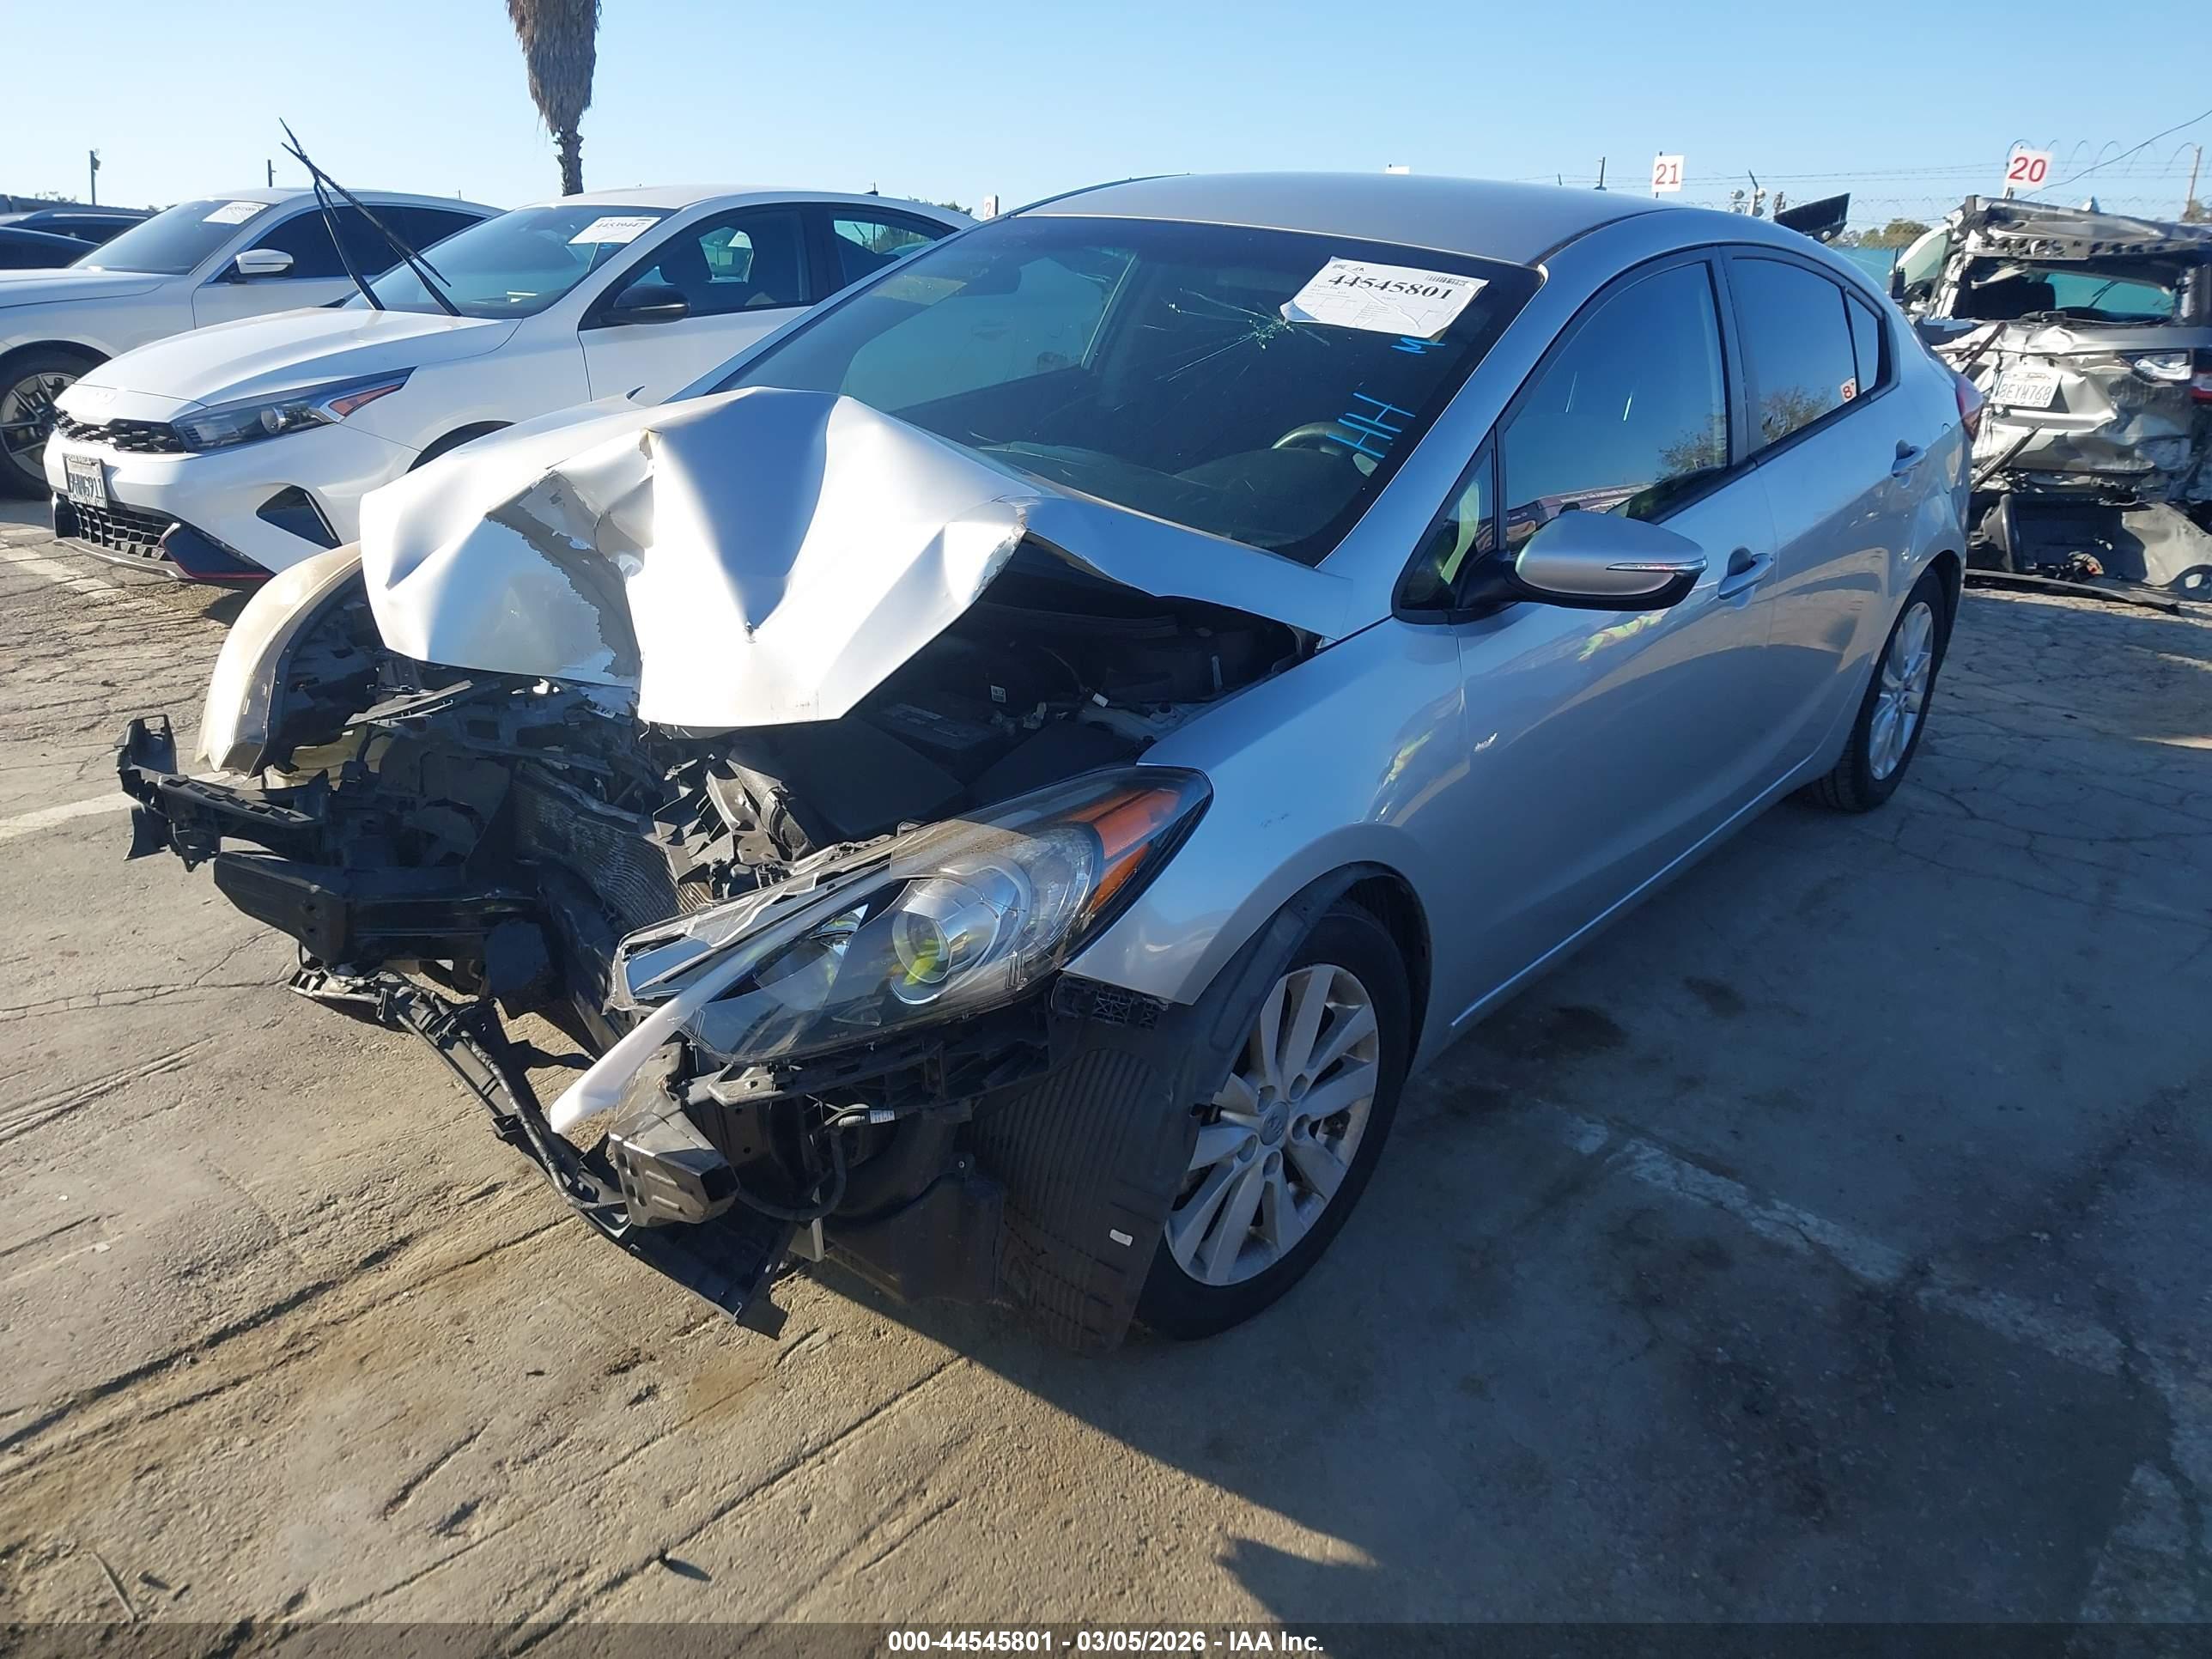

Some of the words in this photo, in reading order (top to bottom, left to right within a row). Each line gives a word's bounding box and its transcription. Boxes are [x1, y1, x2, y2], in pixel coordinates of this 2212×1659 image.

[1655, 163, 1680, 185] 21
[2008, 156, 2046, 182] 20
[1328, 274, 1453, 300] 44545801
